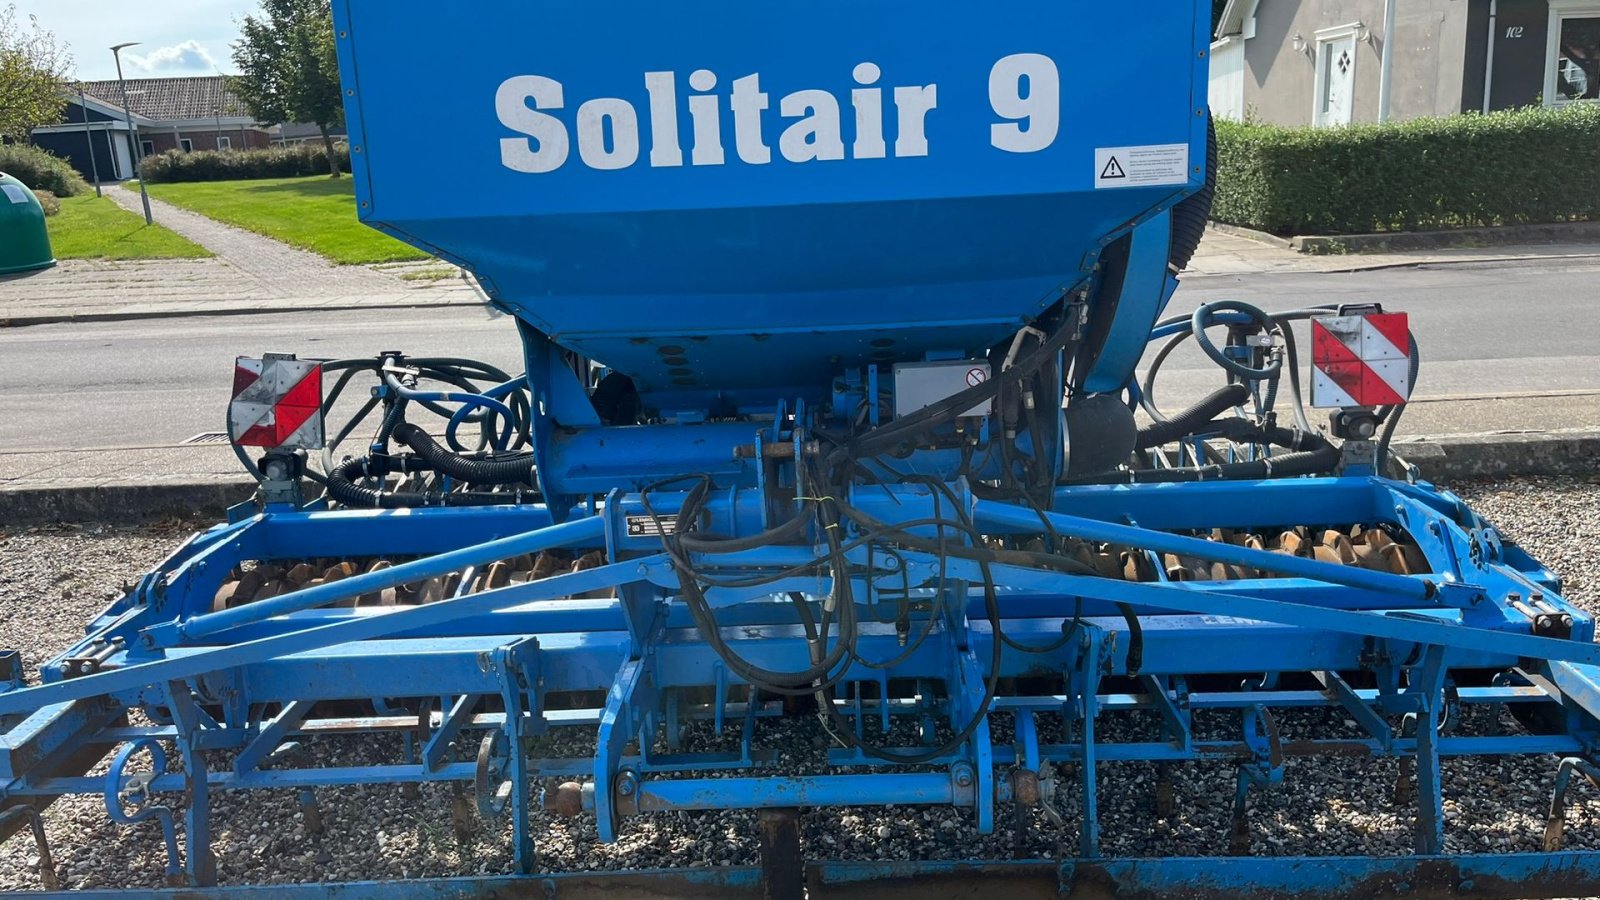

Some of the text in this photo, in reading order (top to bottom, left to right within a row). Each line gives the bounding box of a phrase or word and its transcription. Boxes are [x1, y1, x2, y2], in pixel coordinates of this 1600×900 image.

[1505, 26, 1524, 38] 102
[494, 52, 1061, 174] Solitair 9
